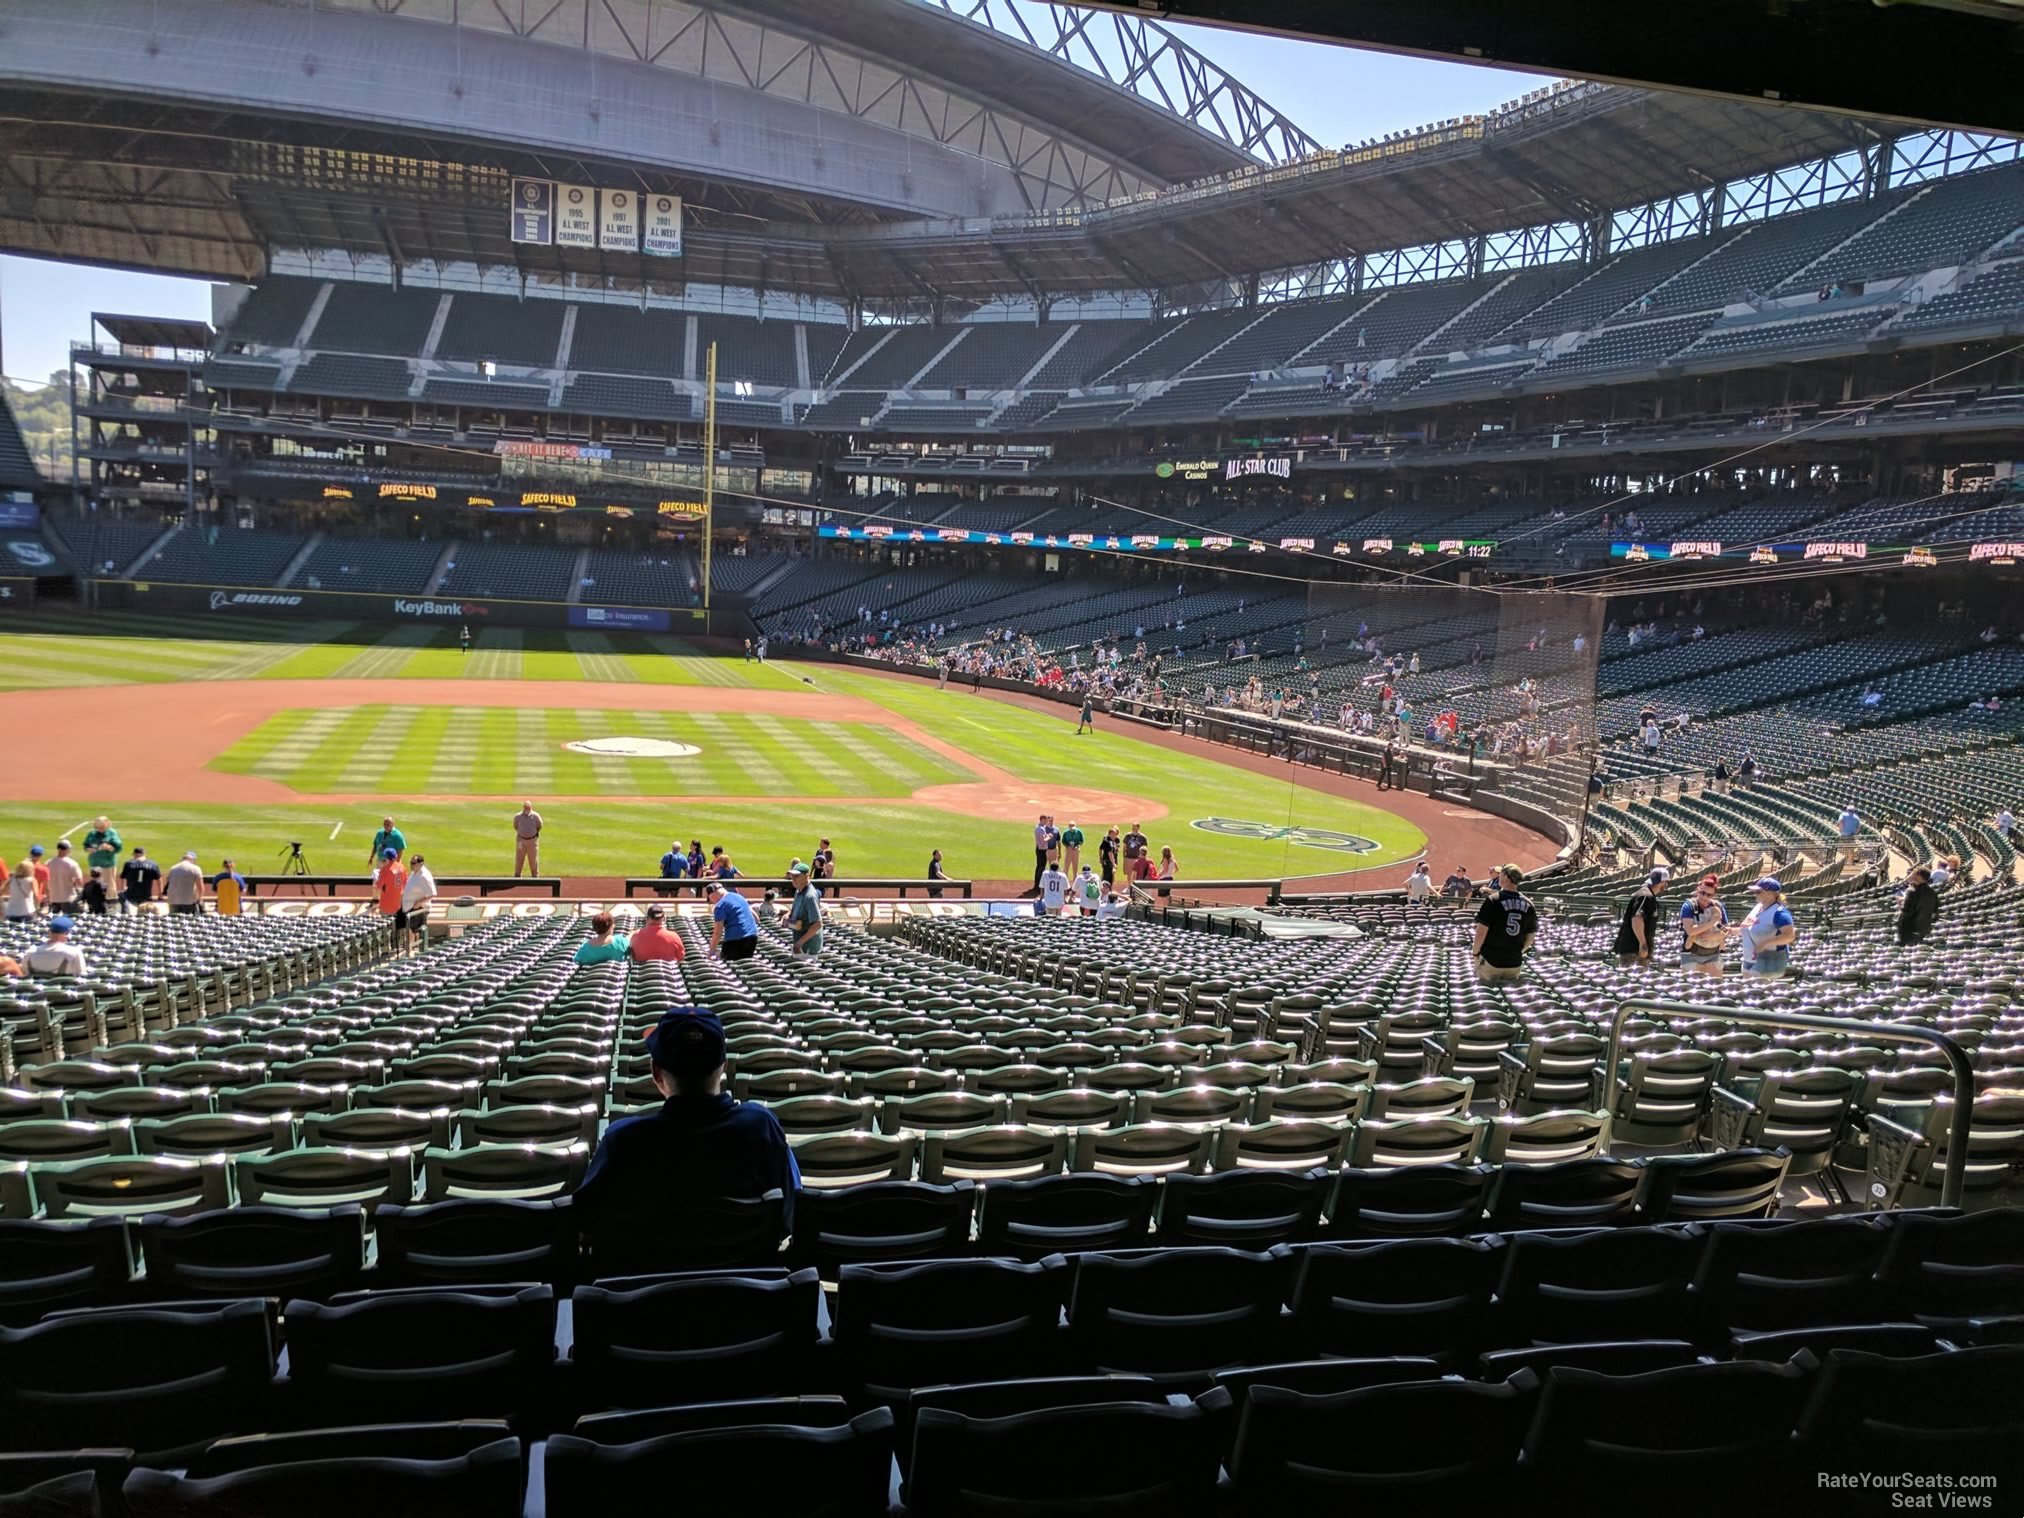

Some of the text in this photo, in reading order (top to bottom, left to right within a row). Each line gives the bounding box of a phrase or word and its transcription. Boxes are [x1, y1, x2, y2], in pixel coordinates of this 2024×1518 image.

[569, 208, 584, 218] 1995
[612, 212, 626, 222] 1997
[573, 222, 590, 231] WEST
[656, 216, 671, 227] 2001
[616, 225, 632, 234] WEST
[660, 230, 676, 238] WEST
[558, 231, 592, 243] CHAMPIONS
[602, 235, 636, 247] CHAMPIONS
[646, 239, 680, 251] CHAMPIONS
[1176, 460, 1218, 470] EMERALD QUEEN
[1267, 458, 1290, 478] CLUB
[1185, 471, 1208, 480] CASINOS
[379, 484, 437, 499] SAFECO FIELD
[521, 493, 576, 507] SAFECO FIELD
[658, 502, 686, 514] SAFECO
[1469, 546, 1490, 557] 11:22
[1670, 542, 1721, 557] SAFECO FIELD
[1804, 544, 1836, 559] SAFECO
[1836, 544, 1866, 558] FIELD
[1968, 544, 2006, 562] SAFECO
[232, 594, 302, 606] BOEING
[395, 600, 462, 616] KeyBank
[615, 611, 649, 620] Insurance
[1050, 880, 1060, 892] 01
[475, 903, 556, 917] TO
[1506, 912, 1522, 936] 5
